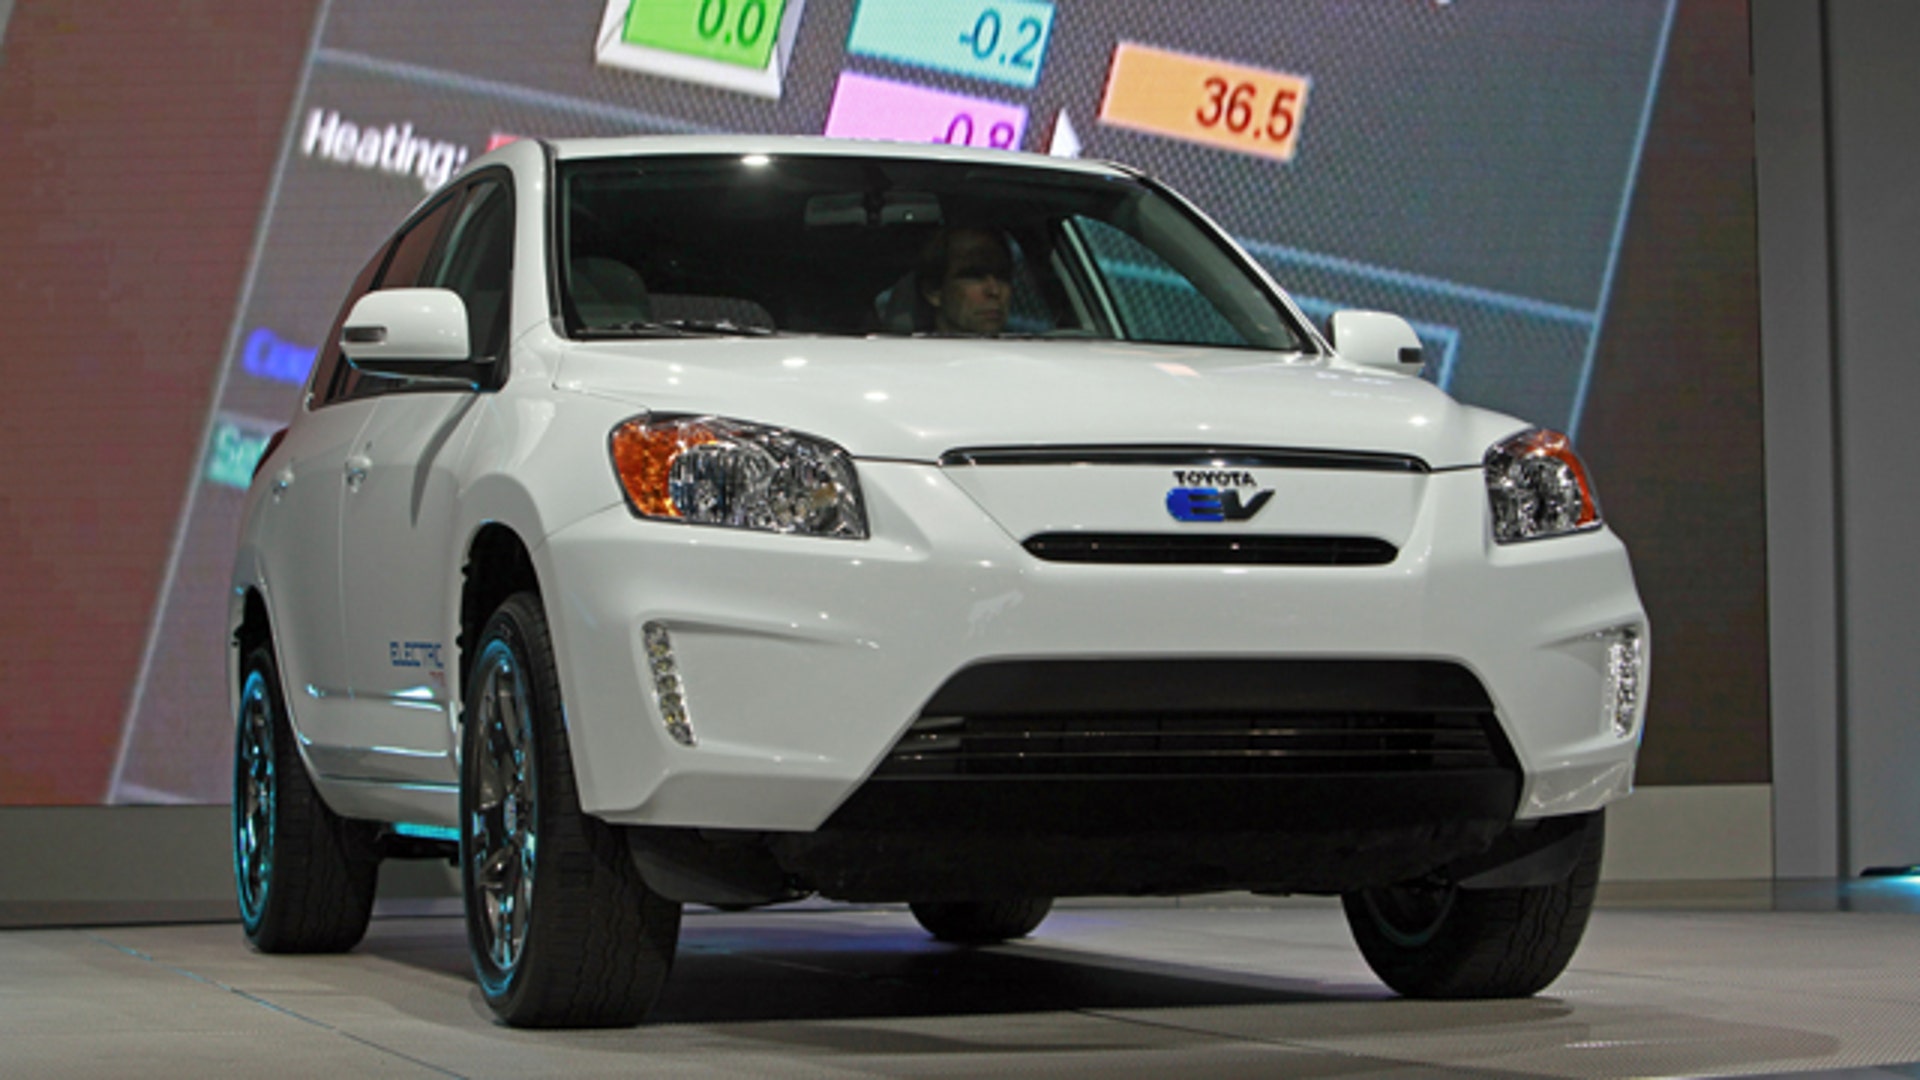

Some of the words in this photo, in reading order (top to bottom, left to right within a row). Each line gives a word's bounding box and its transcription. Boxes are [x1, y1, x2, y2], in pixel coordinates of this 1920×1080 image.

[698, 0, 766, 48] 0.0
[959, 8, 1042, 69] -0.2
[1196, 77, 1296, 142] 36.5
[303, 107, 468, 192] Heating:
[1165, 487, 1275, 521] EV
[1173, 471, 1257, 486] TOYOTA
